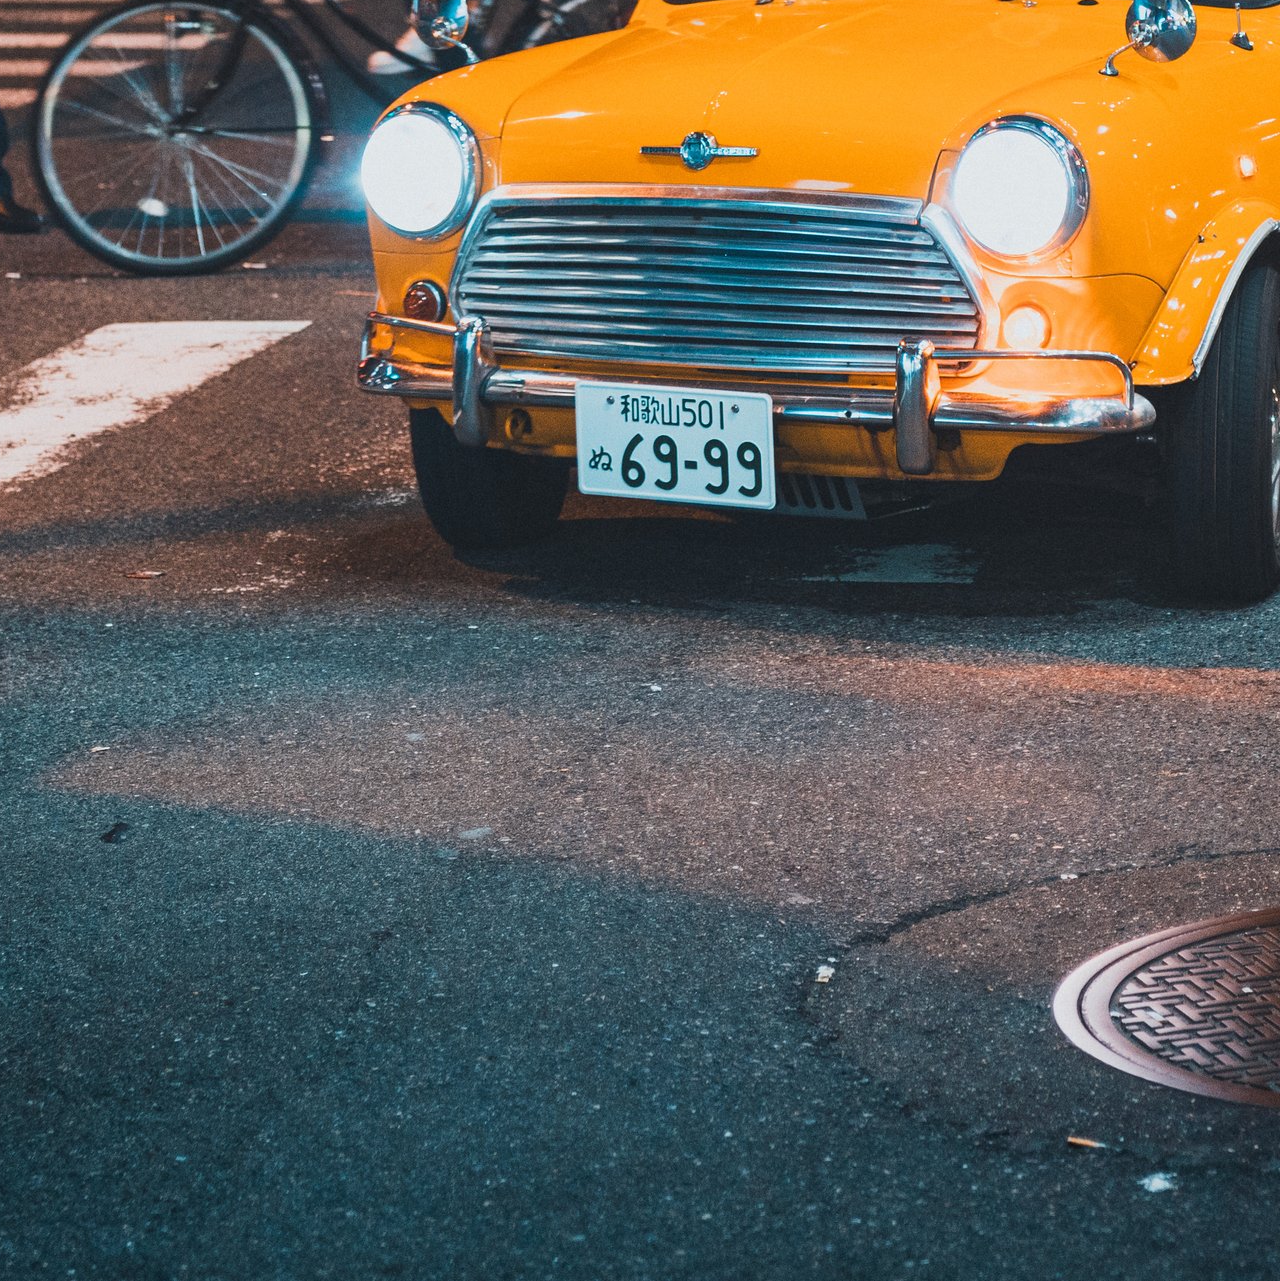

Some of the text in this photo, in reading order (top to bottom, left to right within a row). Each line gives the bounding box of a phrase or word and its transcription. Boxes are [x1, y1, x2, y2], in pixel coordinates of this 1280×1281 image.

[620, 393, 725, 430] 和歌山501
[588, 432, 763, 498] ぬ 69-99
